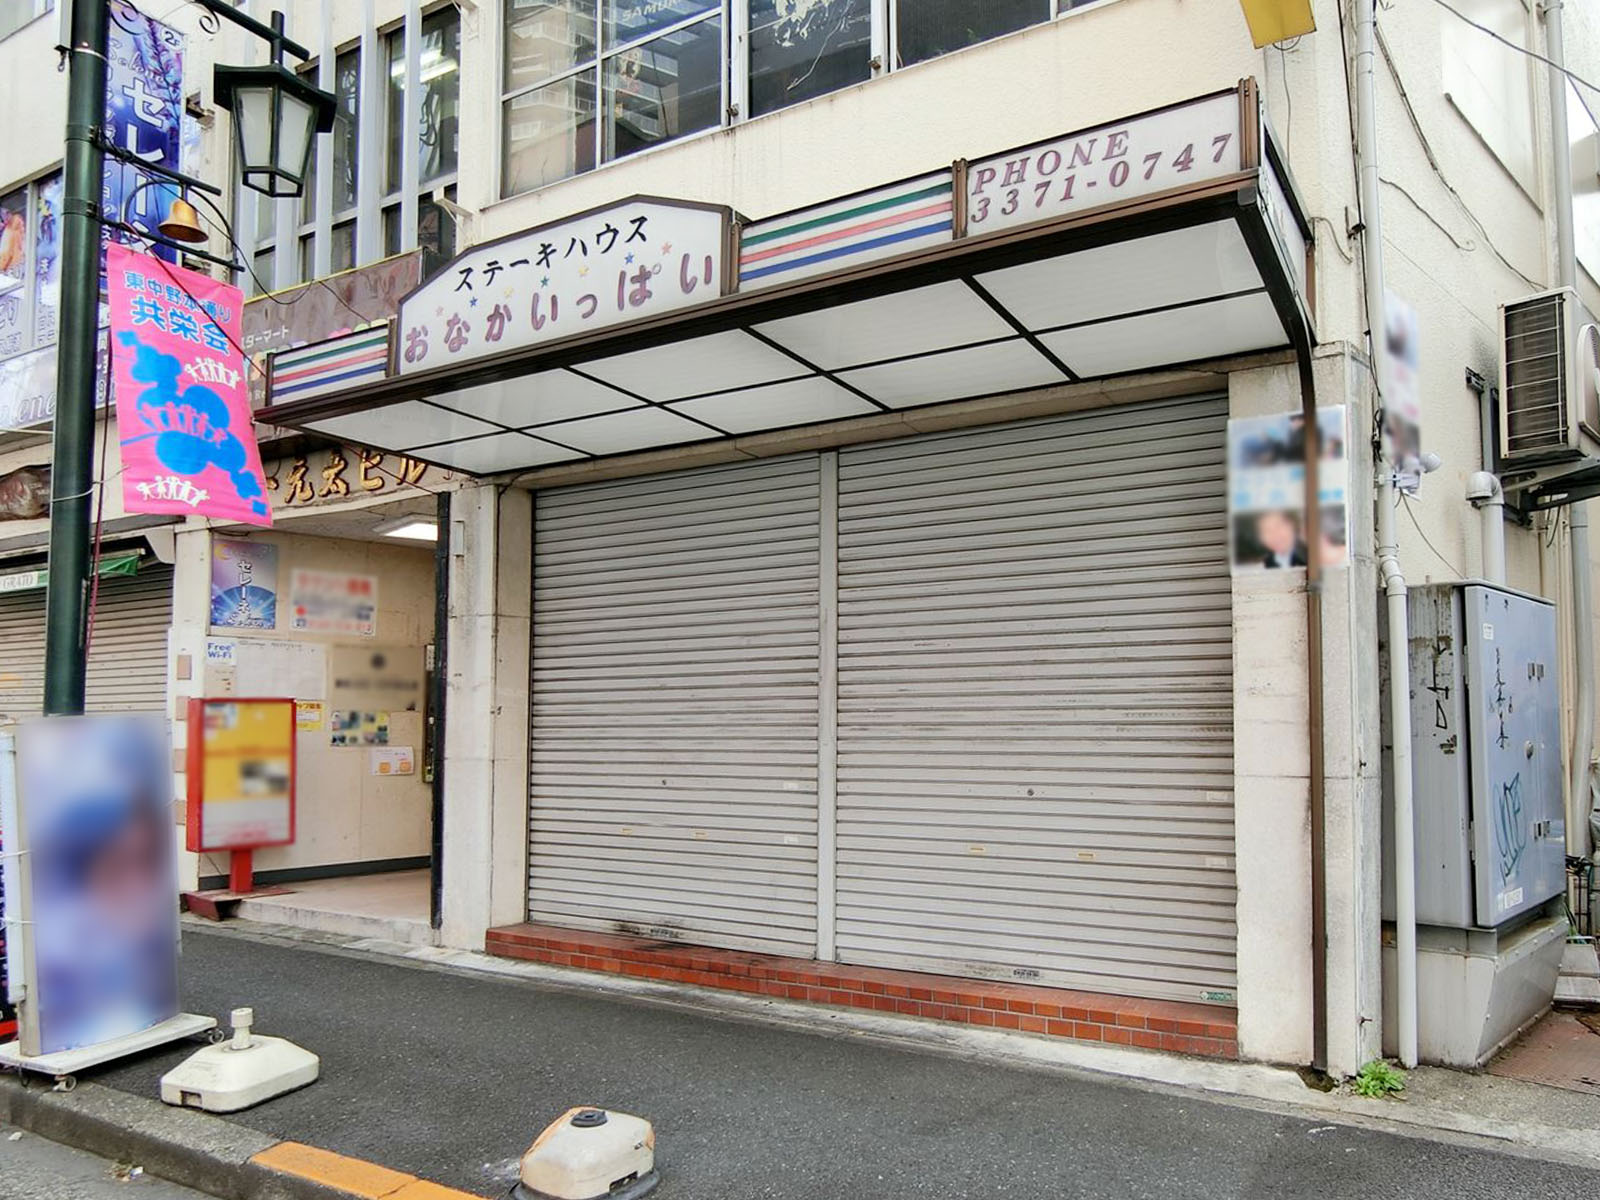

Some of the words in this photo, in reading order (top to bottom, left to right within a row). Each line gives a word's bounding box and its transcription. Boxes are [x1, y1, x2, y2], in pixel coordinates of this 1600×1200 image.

[971, 130, 1130, 196] PHONE
[971, 133, 1232, 224] 3371-0747
[454, 215, 649, 292] ステーキハウス
[124, 270, 231, 323] 東中野本通り
[131, 294, 230, 357] 共栄会
[404, 253, 713, 363] おなかいっぱい
[207, 642, 232, 651] Free
[207, 651, 232, 659] Wi-Fi
